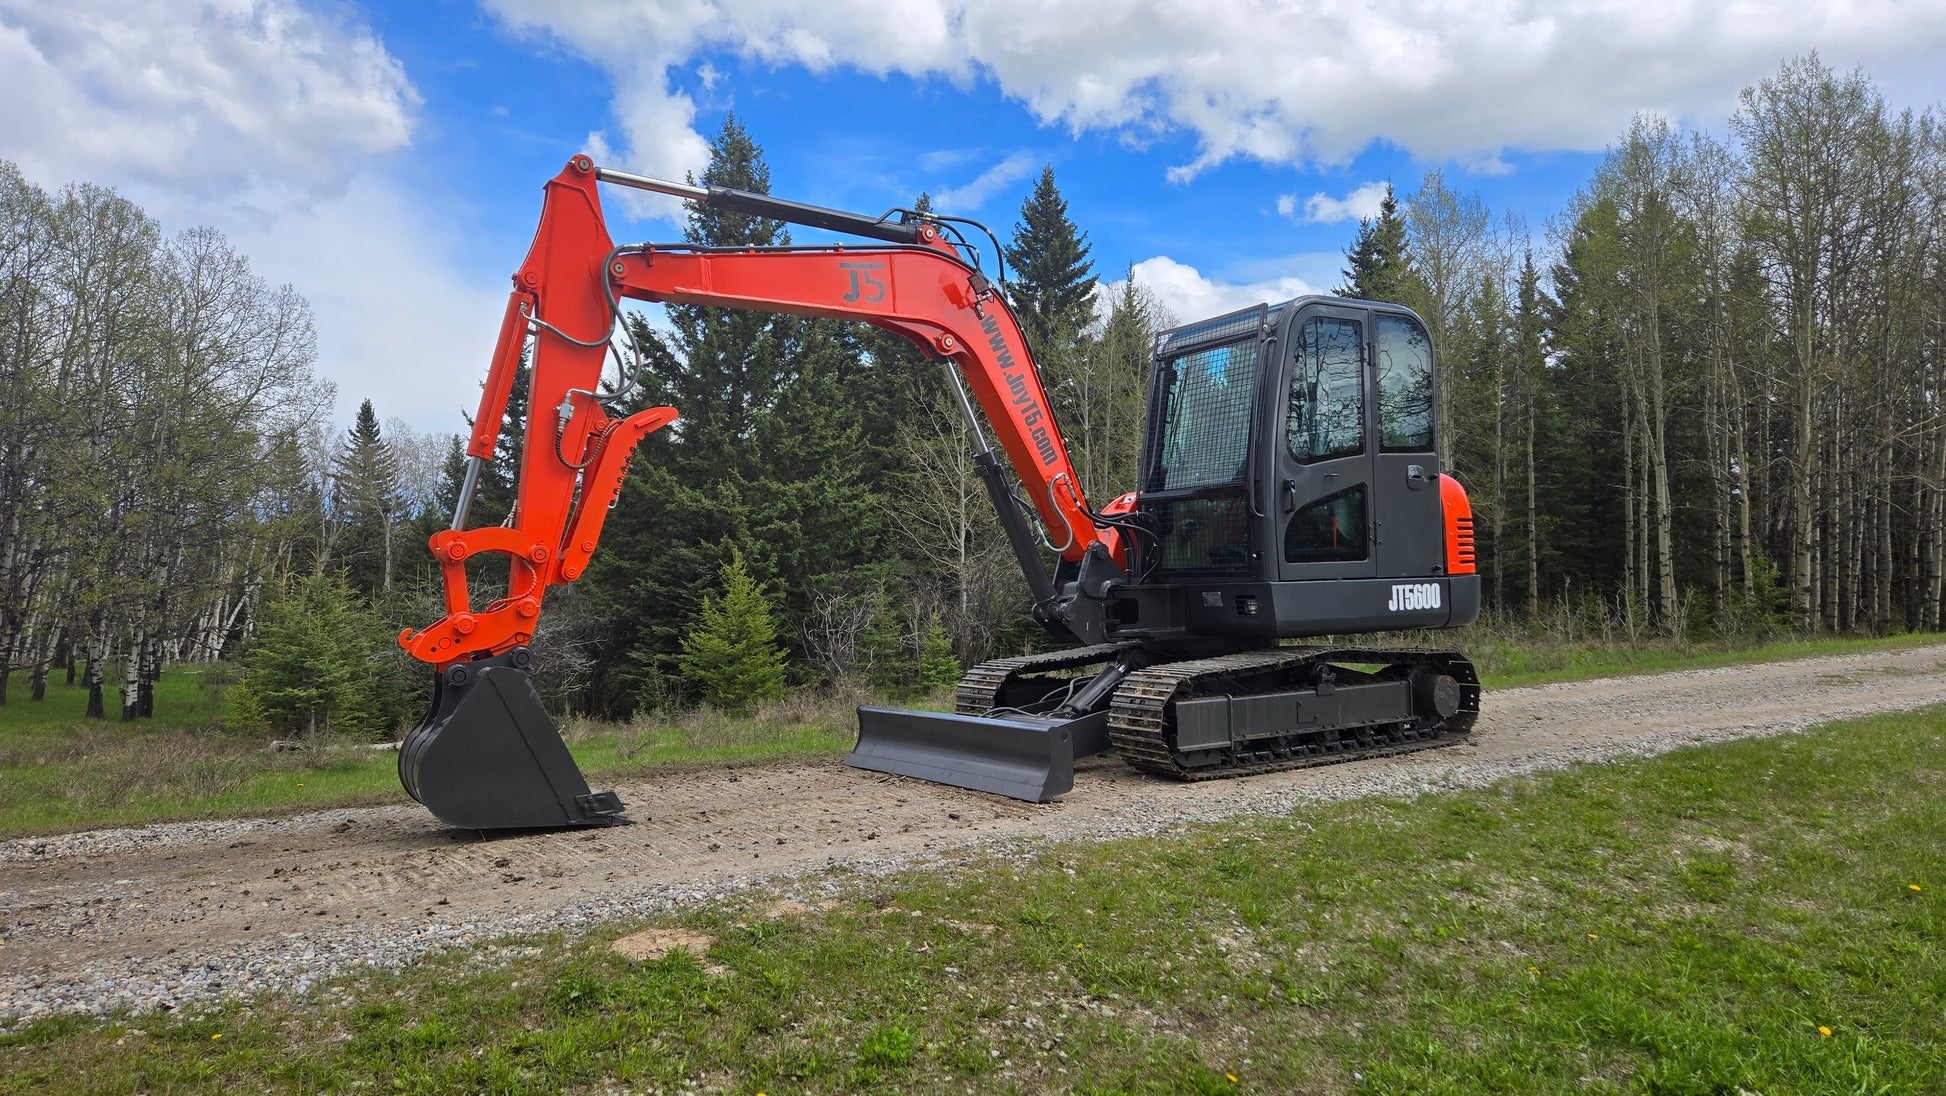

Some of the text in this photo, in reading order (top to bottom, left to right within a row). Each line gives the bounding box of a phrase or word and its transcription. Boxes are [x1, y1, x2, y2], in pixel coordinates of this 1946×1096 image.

[839, 262, 885, 302] J5
[980, 314, 1058, 466] www.JoyT5.com
[1389, 583, 1441, 611] JT5600
